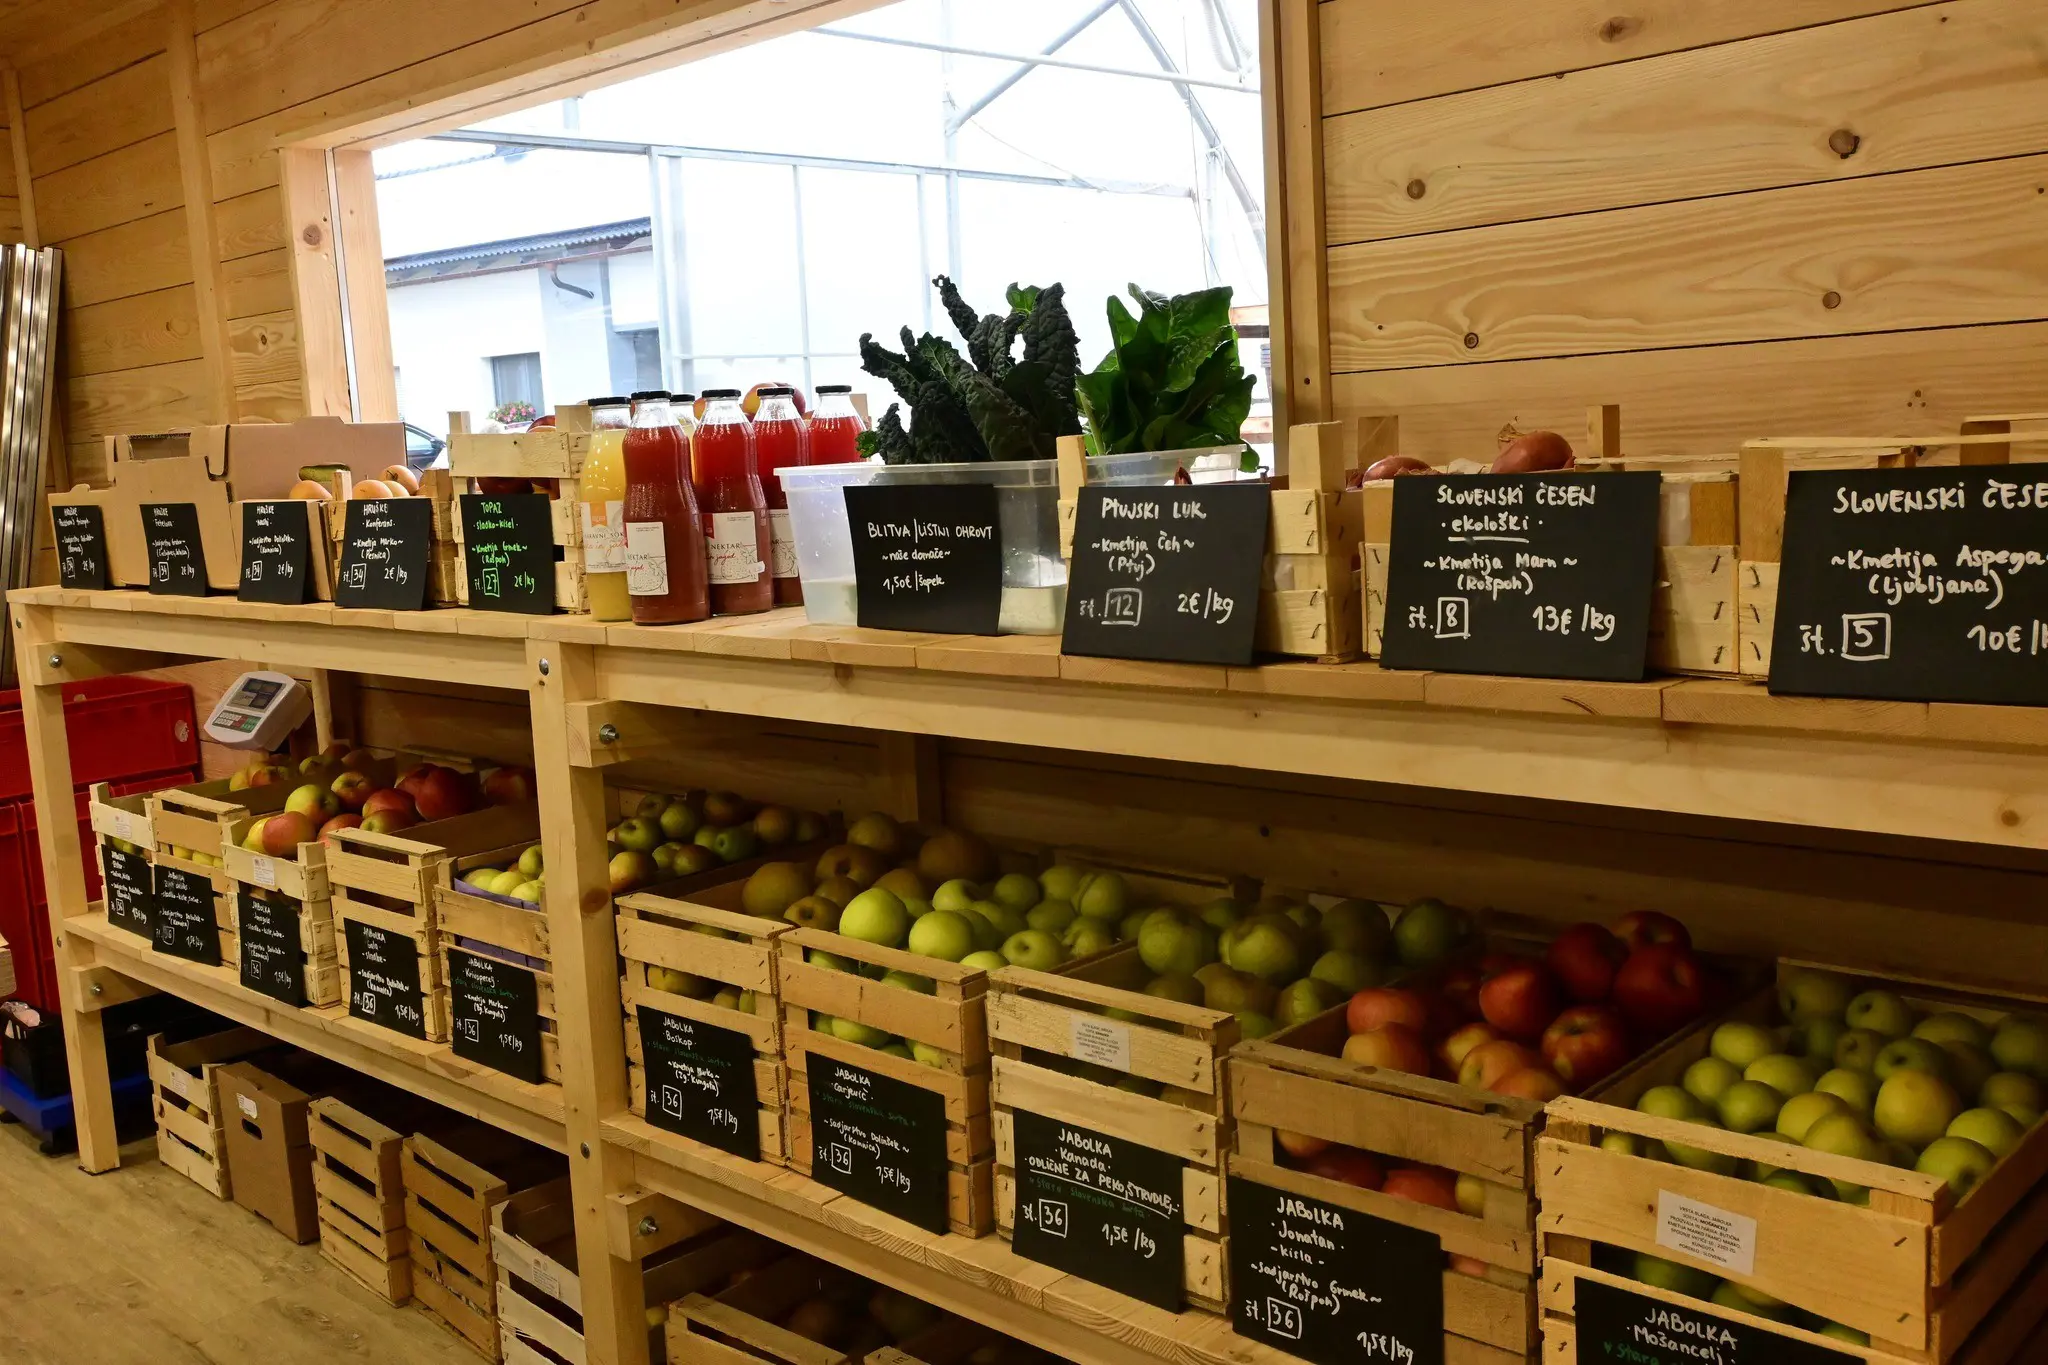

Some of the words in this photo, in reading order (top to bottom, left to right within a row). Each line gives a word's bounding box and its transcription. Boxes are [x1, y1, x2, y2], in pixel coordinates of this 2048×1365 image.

[363, 501, 388, 515] HRUŠKE
[481, 501, 502, 514] TOPAZ
[1436, 483, 1524, 506] SLOVENSKI
[1535, 482, 1597, 507] ČESEN
[1833, 481, 1966, 514] SLOVENSKI
[1173, 501, 1206, 519] LUK
[1451, 511, 1530, 532] ekološki
[955, 525, 993, 540] OHROVT
[1101, 536, 1148, 558] Kmetija
[1157, 530, 1180, 553] Čeh
[278, 561, 293, 578] 2€/kg
[353, 568, 364, 582] 34
[1108, 554, 1155, 582] (Ptuj)
[1439, 552, 1503, 575] Kmetija
[1847, 546, 1938, 579] Kmetija
[486, 574, 498, 592] 27
[1456, 570, 1534, 602] (Rošpoh)
[1868, 569, 2004, 610] (Ljubljana)
[1110, 594, 1134, 616] 12
[1408, 605, 1435, 630] št.
[1446, 602, 1458, 628] 8
[1799, 623, 1835, 656] št.
[1852, 619, 1879, 648] 5
[365, 995, 374, 1009] 36
[395, 1004, 420, 1026] 1,5€/kg
[468, 1022, 476, 1036] 36
[499, 1034, 523, 1052] 1,5€/kg
[662, 1016, 694, 1035] JABOLKA
[834, 1066, 871, 1087] JABOLKA
[665, 1091, 679, 1108] 36
[707, 1108, 738, 1134] 1,5€/kg
[1058, 1128, 1112, 1158] JABOLKA
[835, 1148, 849, 1166] 36
[875, 1165, 911, 1194] 1,5€/kg
[1028, 1154, 1070, 1177] ODLIČNE
[1074, 1168, 1090, 1184] ZA
[1060, 1146, 1108, 1172] Kanada
[1043, 1204, 1064, 1227] 36
[1276, 1196, 1345, 1231] JABOLKA
[1278, 1219, 1335, 1250] Jonatan
[1279, 1244, 1313, 1265] kisla
[1271, 1304, 1294, 1329] 36
[1644, 1307, 1738, 1351] JABOLKA
[1633, 1324, 1723, 1365] Mošancelj
